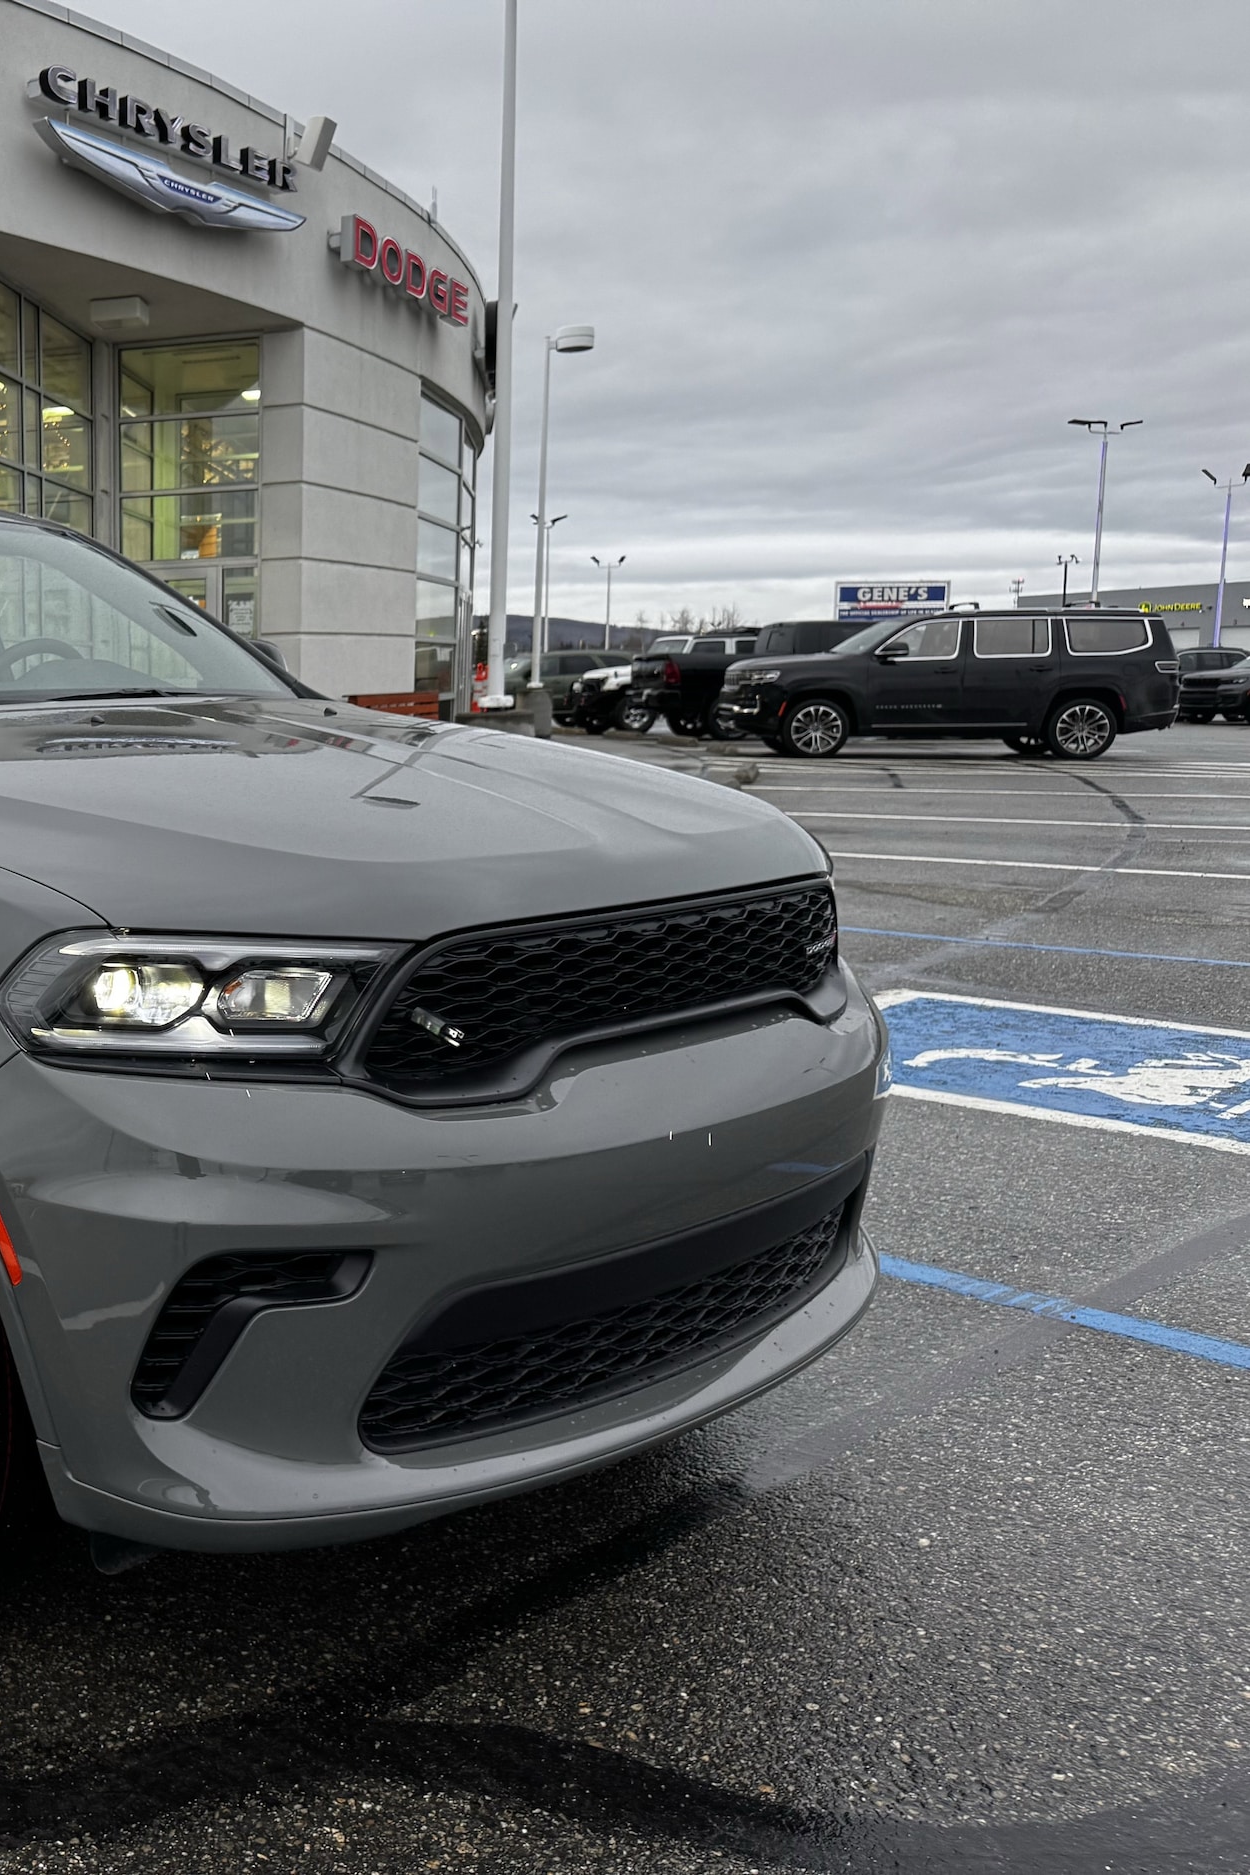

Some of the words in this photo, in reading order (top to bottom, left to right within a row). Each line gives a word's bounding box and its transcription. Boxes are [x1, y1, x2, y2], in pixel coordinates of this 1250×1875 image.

[40, 64, 298, 193] CHRYSLER
[164, 179, 214, 202] CHRYSLER
[354, 214, 468, 326] DODGE
[857, 587, 928, 601] GENE'S
[1174, 602, 1201, 611] DEERE
